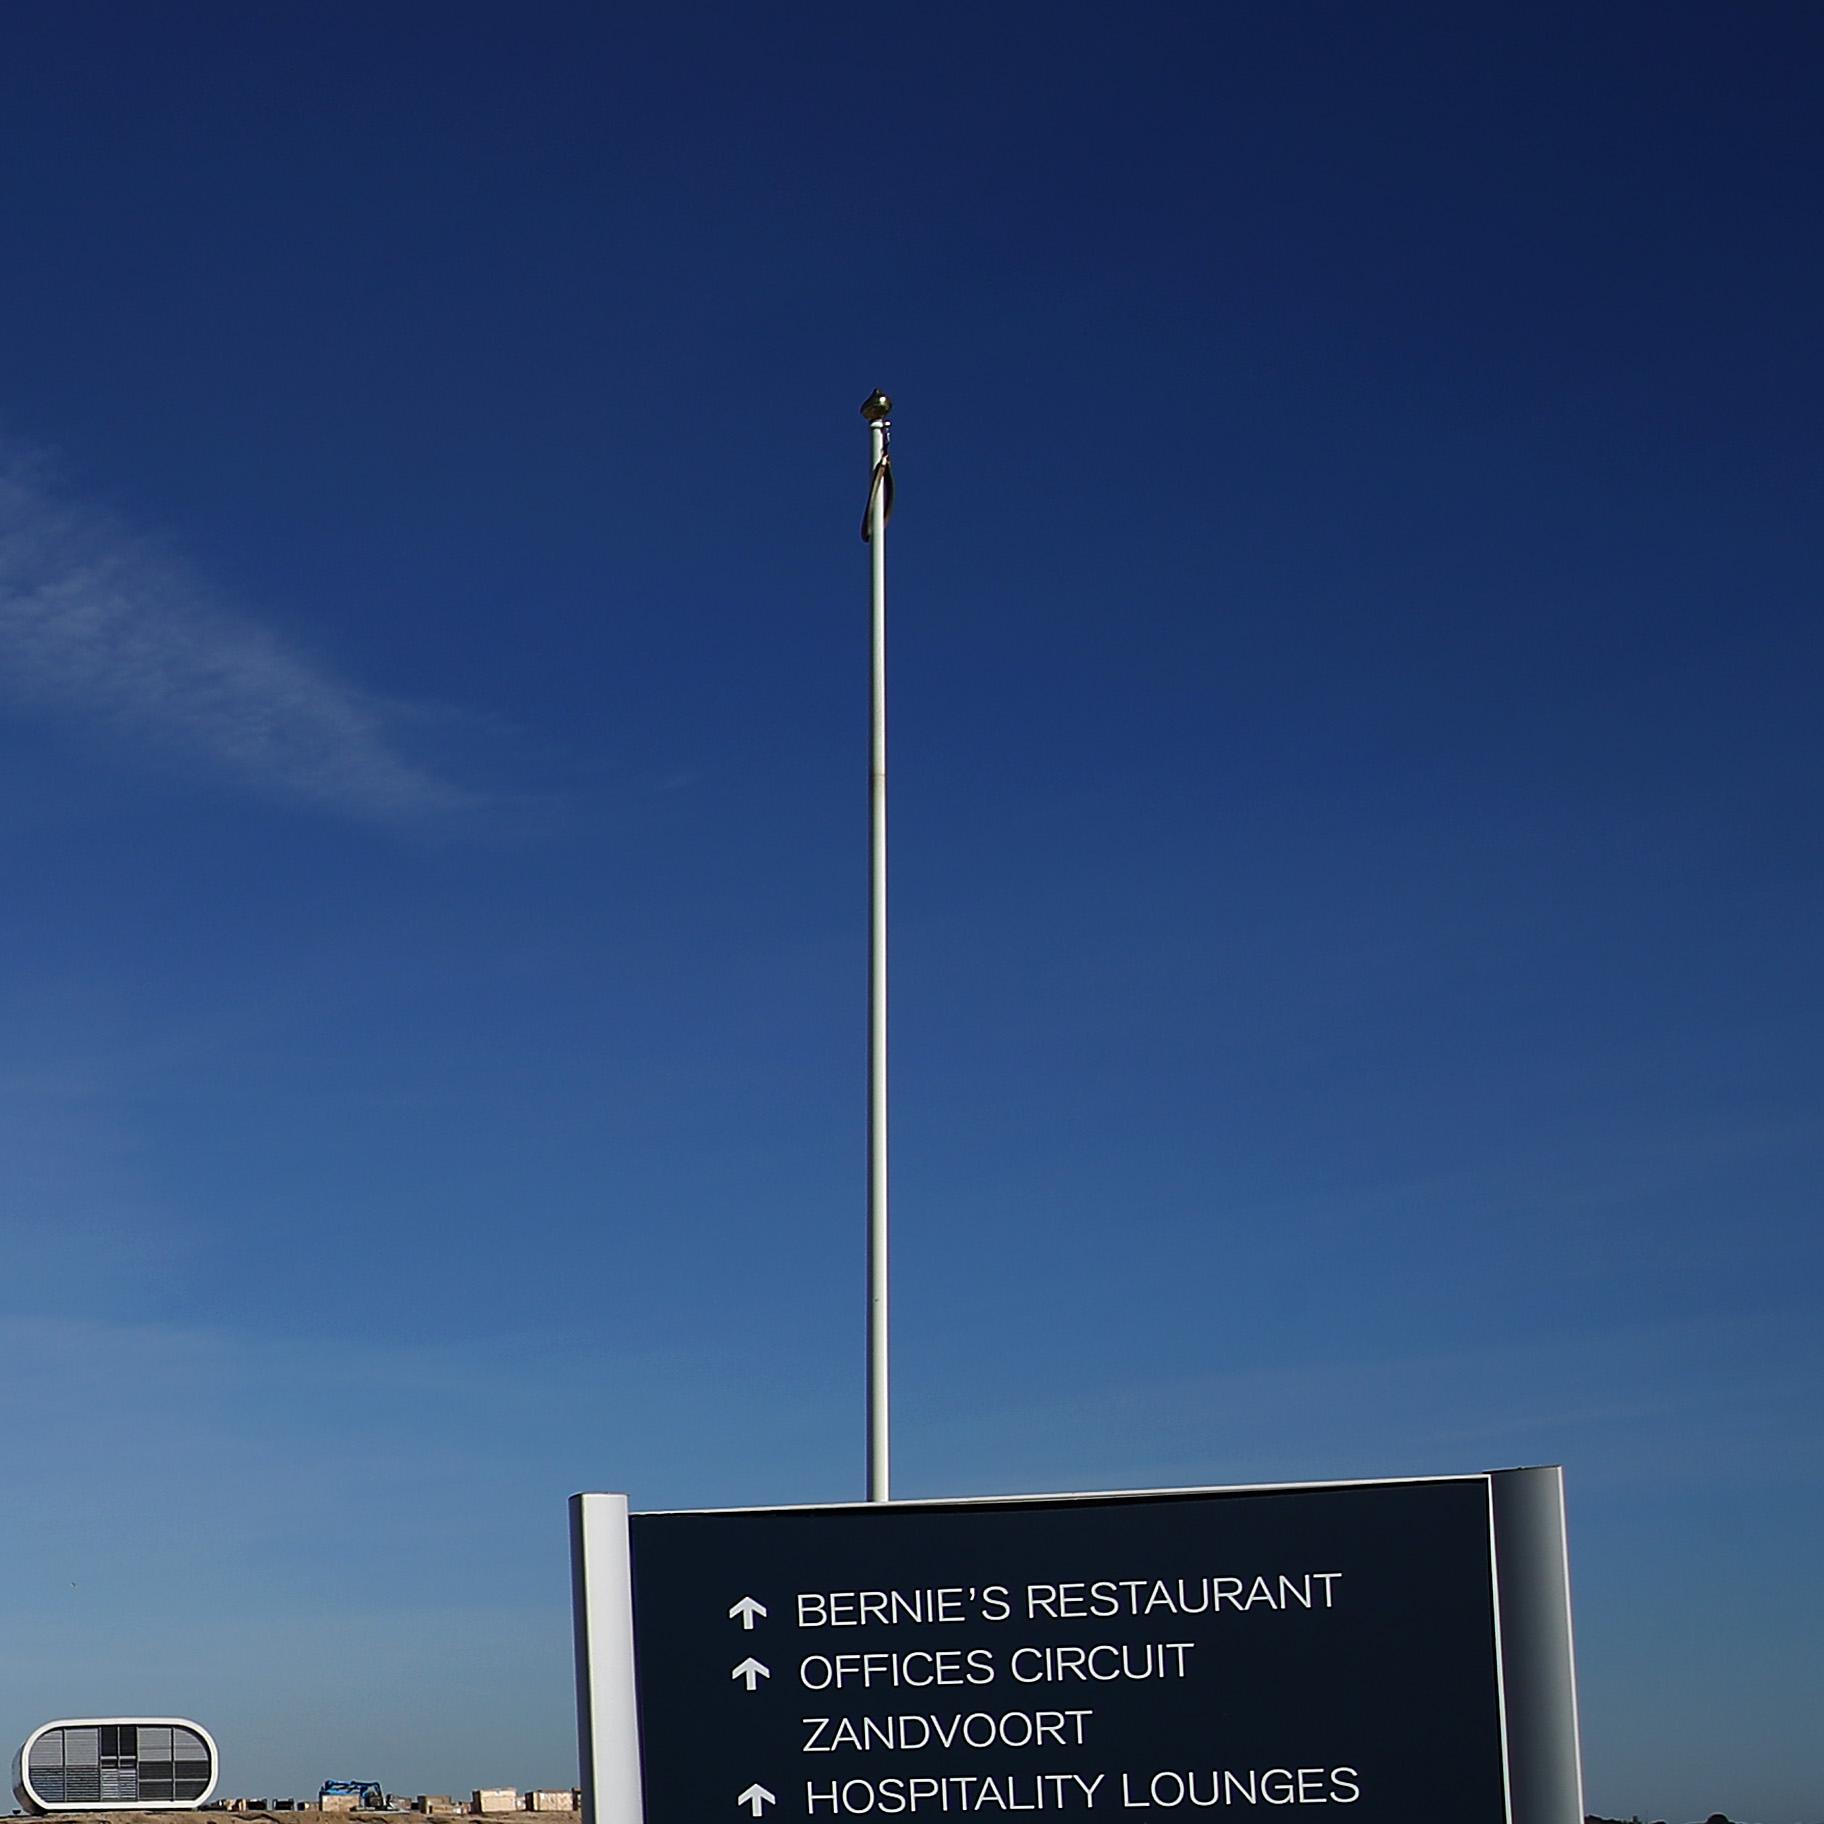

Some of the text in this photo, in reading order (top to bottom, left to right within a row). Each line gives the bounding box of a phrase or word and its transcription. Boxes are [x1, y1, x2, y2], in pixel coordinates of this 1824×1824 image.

[798, 1573, 1342, 1626] BERNIE'S RESTAURANT
[801, 1644, 1194, 1689] OFFICES CIRCUIT
[803, 1711, 1092, 1751] ZANDVOORT
[808, 1767, 1359, 1814] HOSPITALITY LOUNGES
